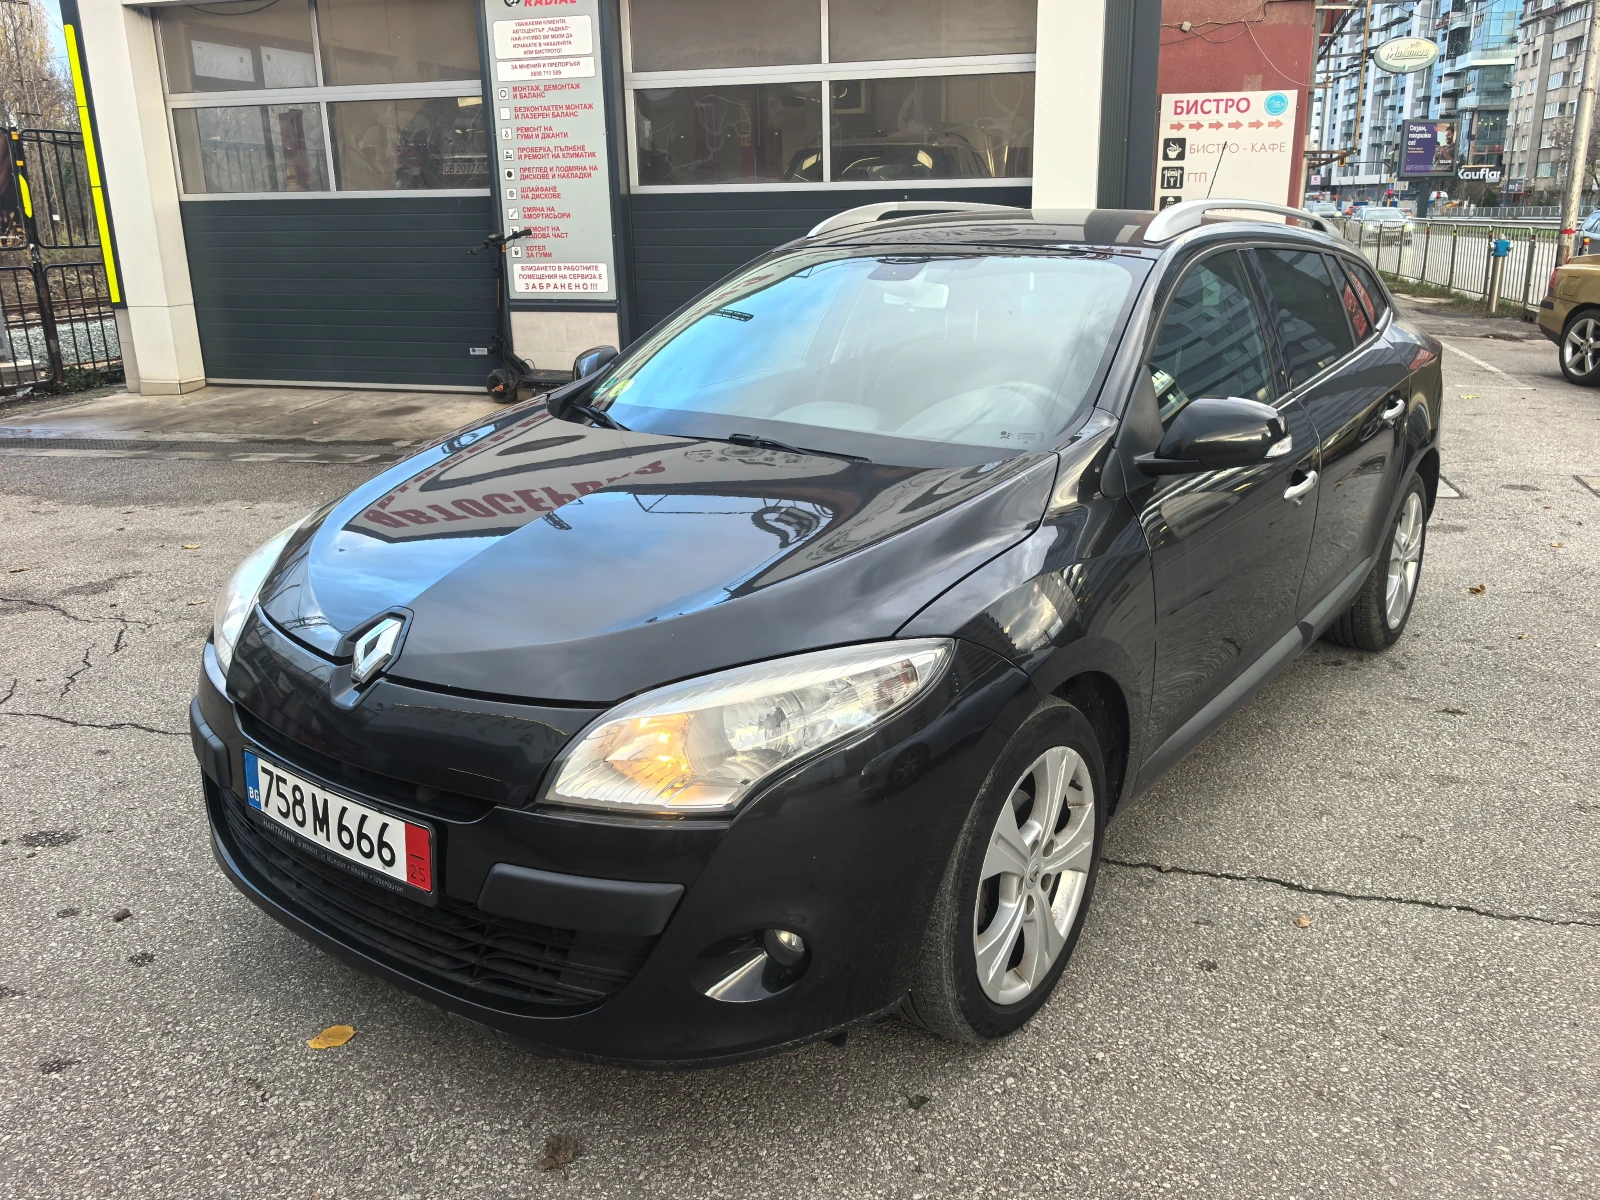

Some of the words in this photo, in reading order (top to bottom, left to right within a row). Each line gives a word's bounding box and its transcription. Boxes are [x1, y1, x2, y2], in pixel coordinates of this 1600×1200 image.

[544, 83, 580, 92] ДЕМОНТАЖ
[1174, 98, 1251, 116] БИСТРО
[541, 132, 568, 140] ДЖАНТИ
[1190, 143, 1239, 154] БИСТРО
[1251, 142, 1286, 152] КАФЕ
[1188, 172, 1208, 182] ГТП
[521, 185, 557, 193] ШЛАЙФАНЕ
[249, 786, 259, 802] BG
[264, 819, 295, 843] HARTMANN
[410, 865, 426, 882] 25
